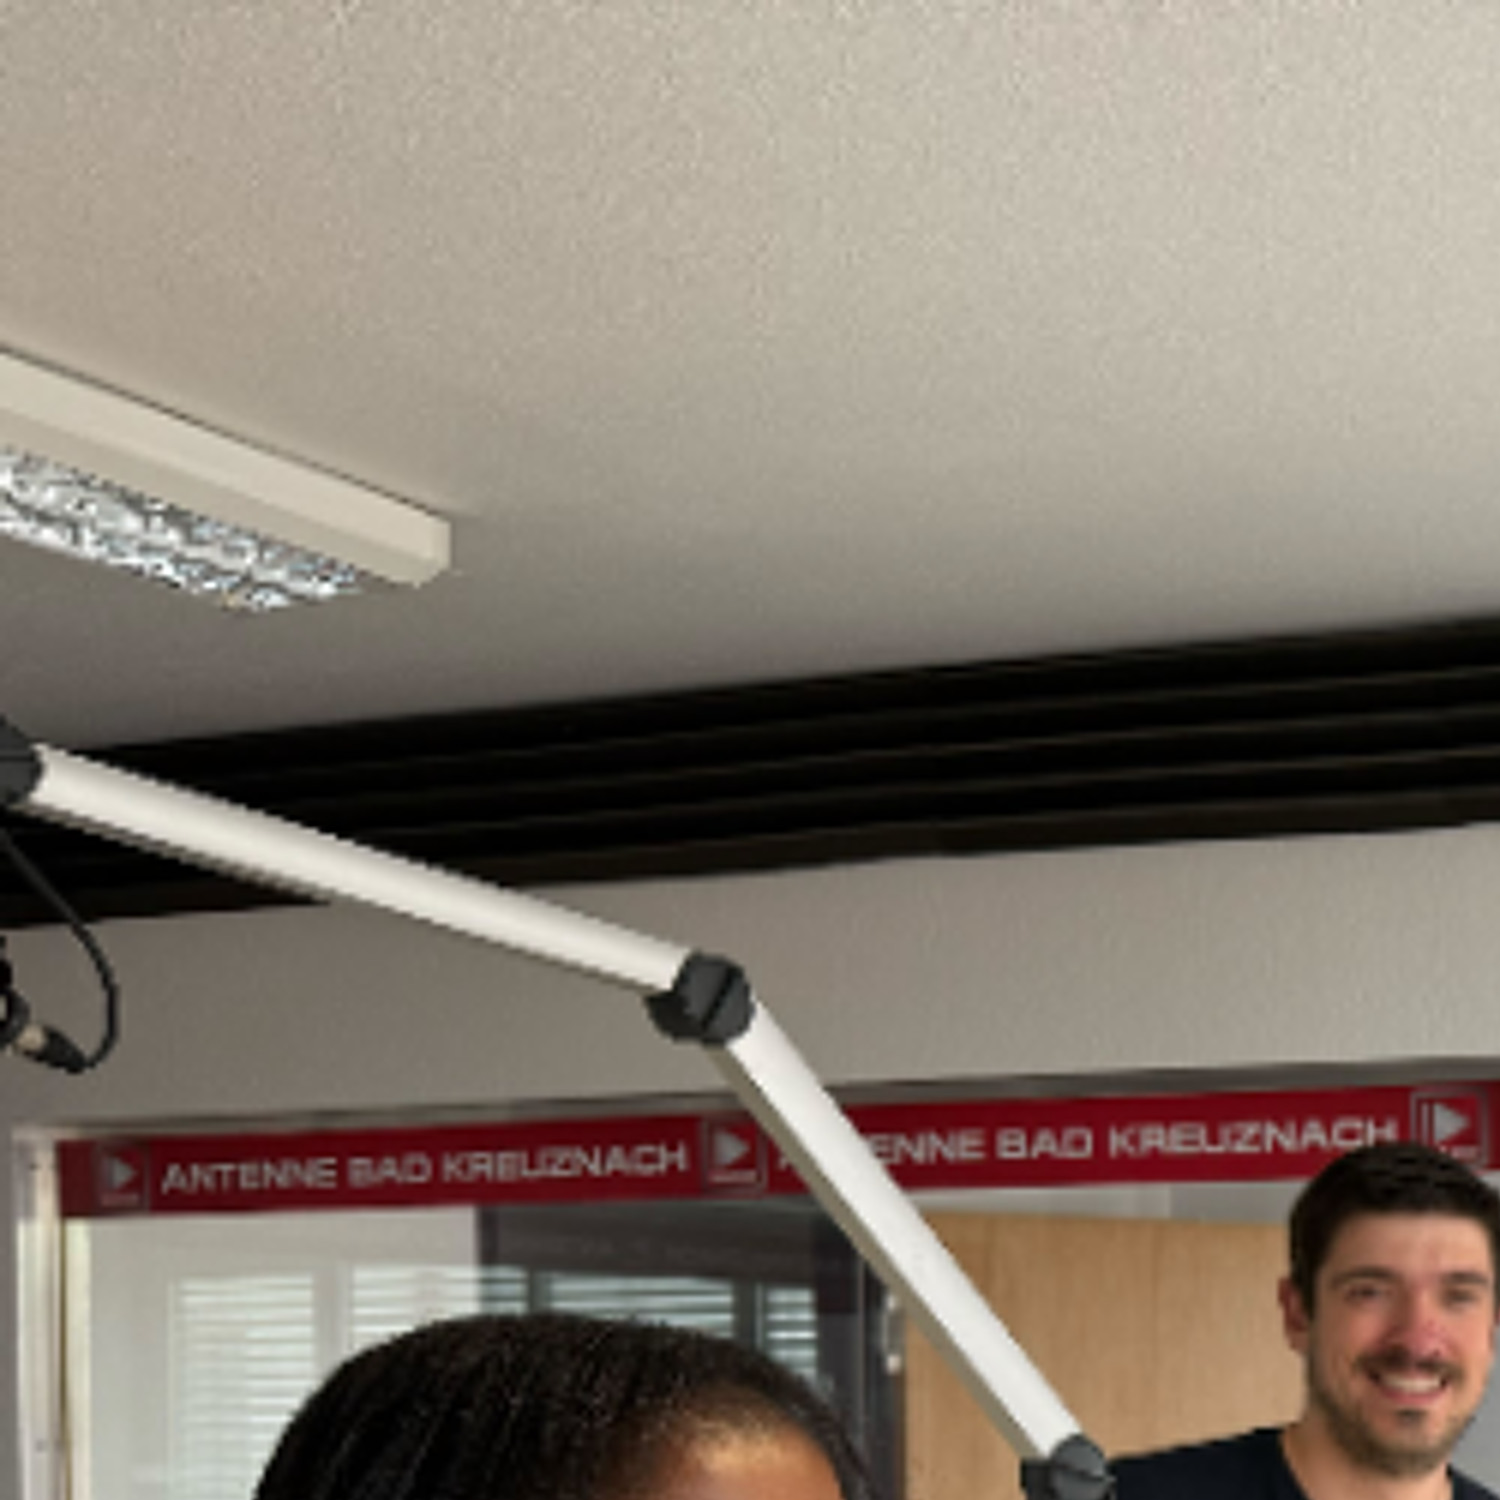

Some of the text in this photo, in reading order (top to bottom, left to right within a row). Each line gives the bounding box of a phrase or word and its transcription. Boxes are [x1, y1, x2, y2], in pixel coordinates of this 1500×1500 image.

[998, 1122, 1094, 1160] BAD
[1107, 1114, 1399, 1157] KREUZNACH
[161, 1140, 688, 1195] ANTENNE BAD KREUZNACH
